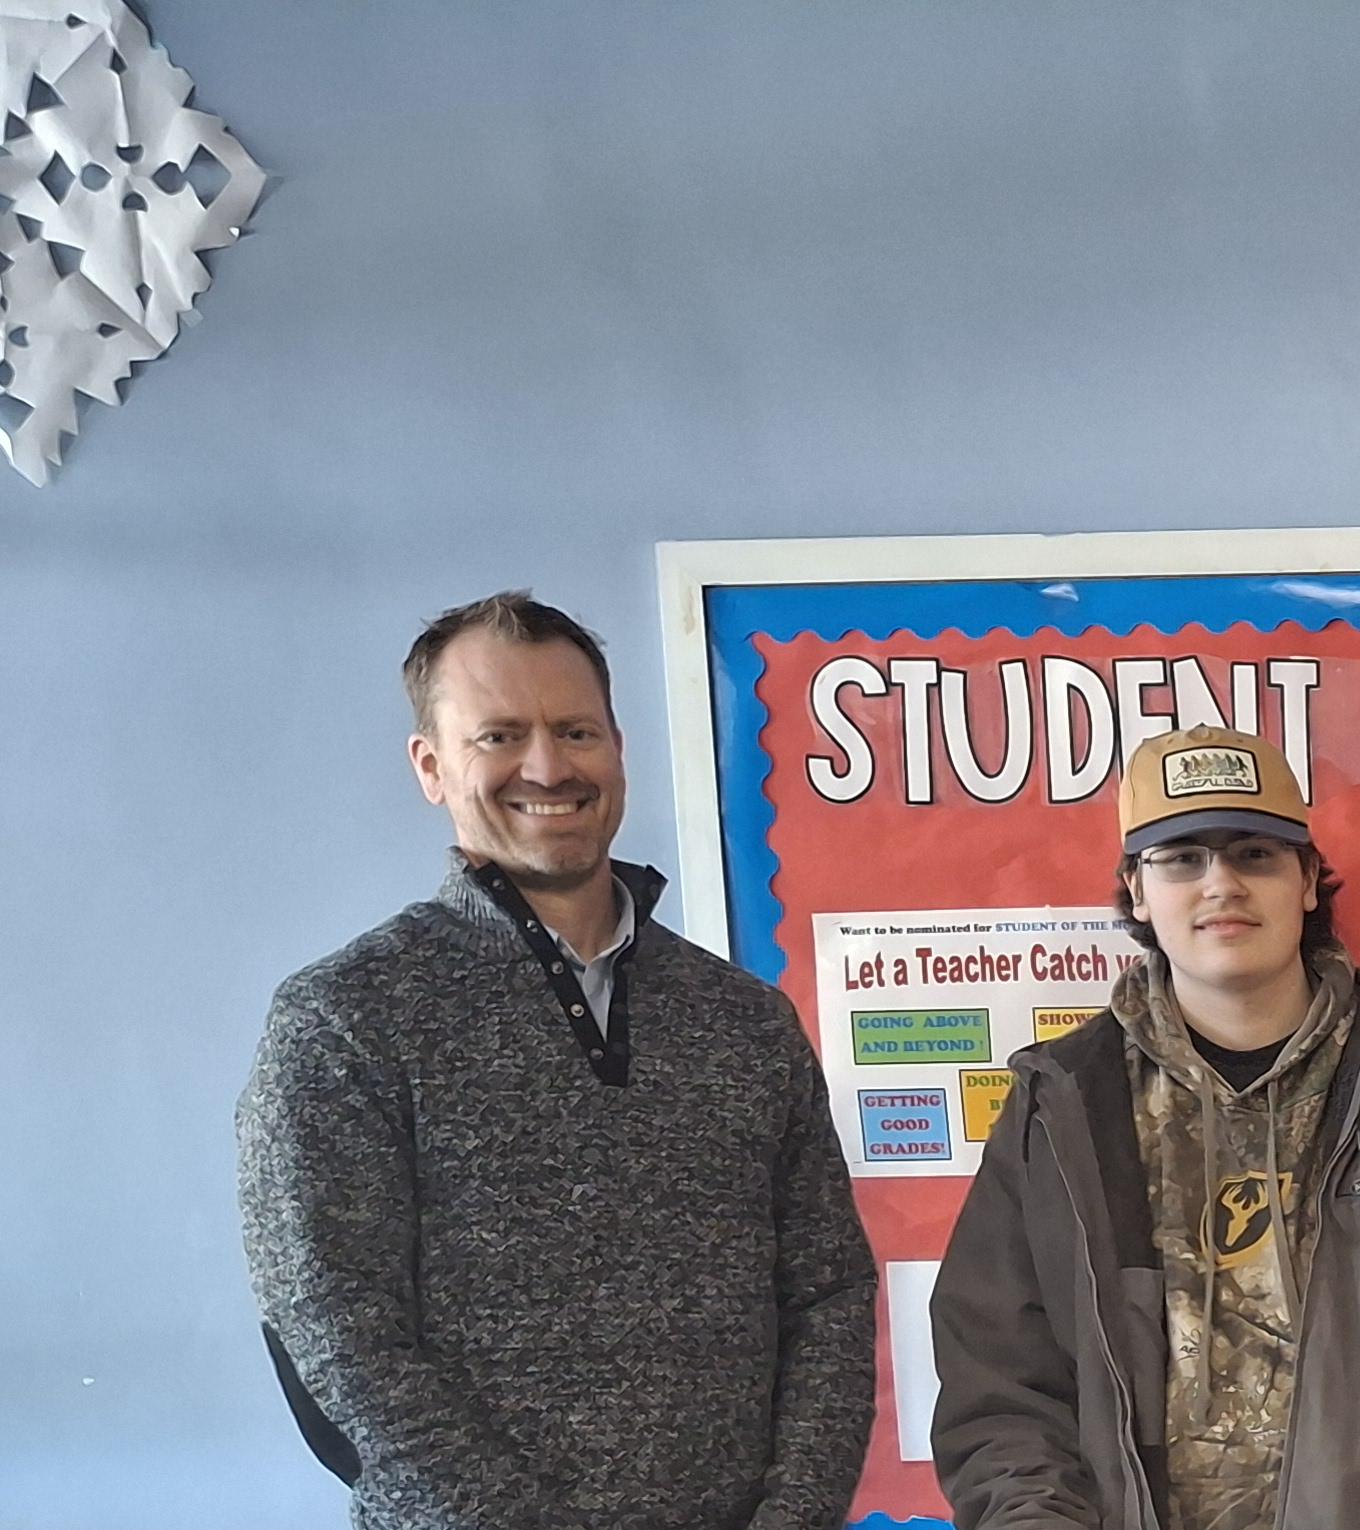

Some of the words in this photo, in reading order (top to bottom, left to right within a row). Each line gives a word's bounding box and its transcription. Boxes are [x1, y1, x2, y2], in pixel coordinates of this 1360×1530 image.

[805, 654, 1321, 805] STUDENT
[840, 926, 871, 936] Want
[874, 926, 887, 935] to
[889, 925, 903, 935] be
[906, 923, 970, 934] nominated
[973, 923, 992, 933] for
[995, 921, 1057, 933] STUDENT
[1061, 921, 1077, 931] OF
[1082, 921, 1108, 931] THE
[845, 951, 885, 991] Let
[893, 956, 909, 987] a
[915, 944, 1022, 985] Teacher
[1030, 943, 1108, 982] Catch
[858, 1016, 915, 1029] GOING
[923, 1015, 983, 1029] ABOVE
[861, 1040, 898, 1053] AND
[903, 1039, 975, 1053] BEYOND
[864, 1094, 941, 1108] GETTING
[881, 1118, 930, 1131] GOOD
[870, 1142, 945, 1156] GRADES!
